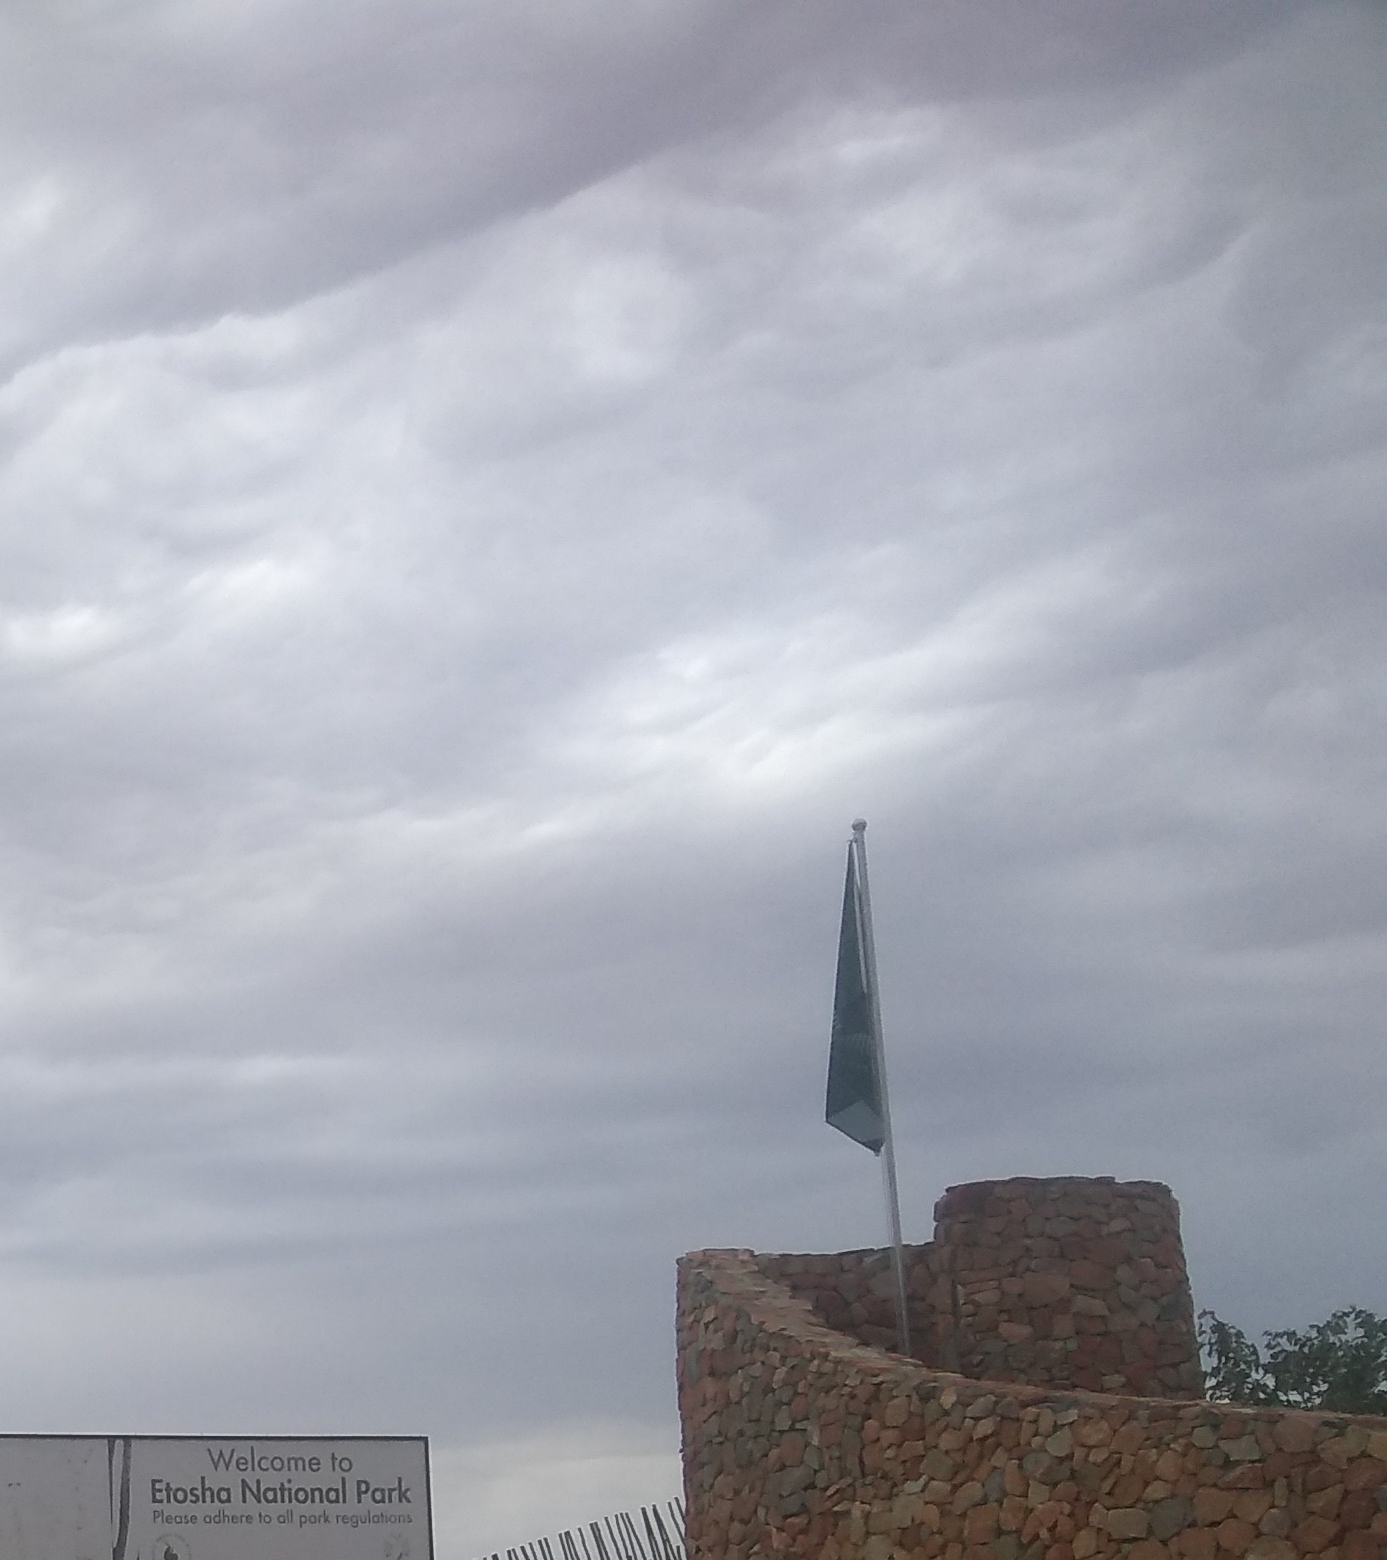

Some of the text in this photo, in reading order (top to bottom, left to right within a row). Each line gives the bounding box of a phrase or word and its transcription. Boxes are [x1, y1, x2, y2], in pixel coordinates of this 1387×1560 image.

[208, 1446, 353, 1473] Welcome to
[151, 1476, 411, 1504] Etosha National Park
[153, 1509, 412, 1530] Please adhere to all park regulations
